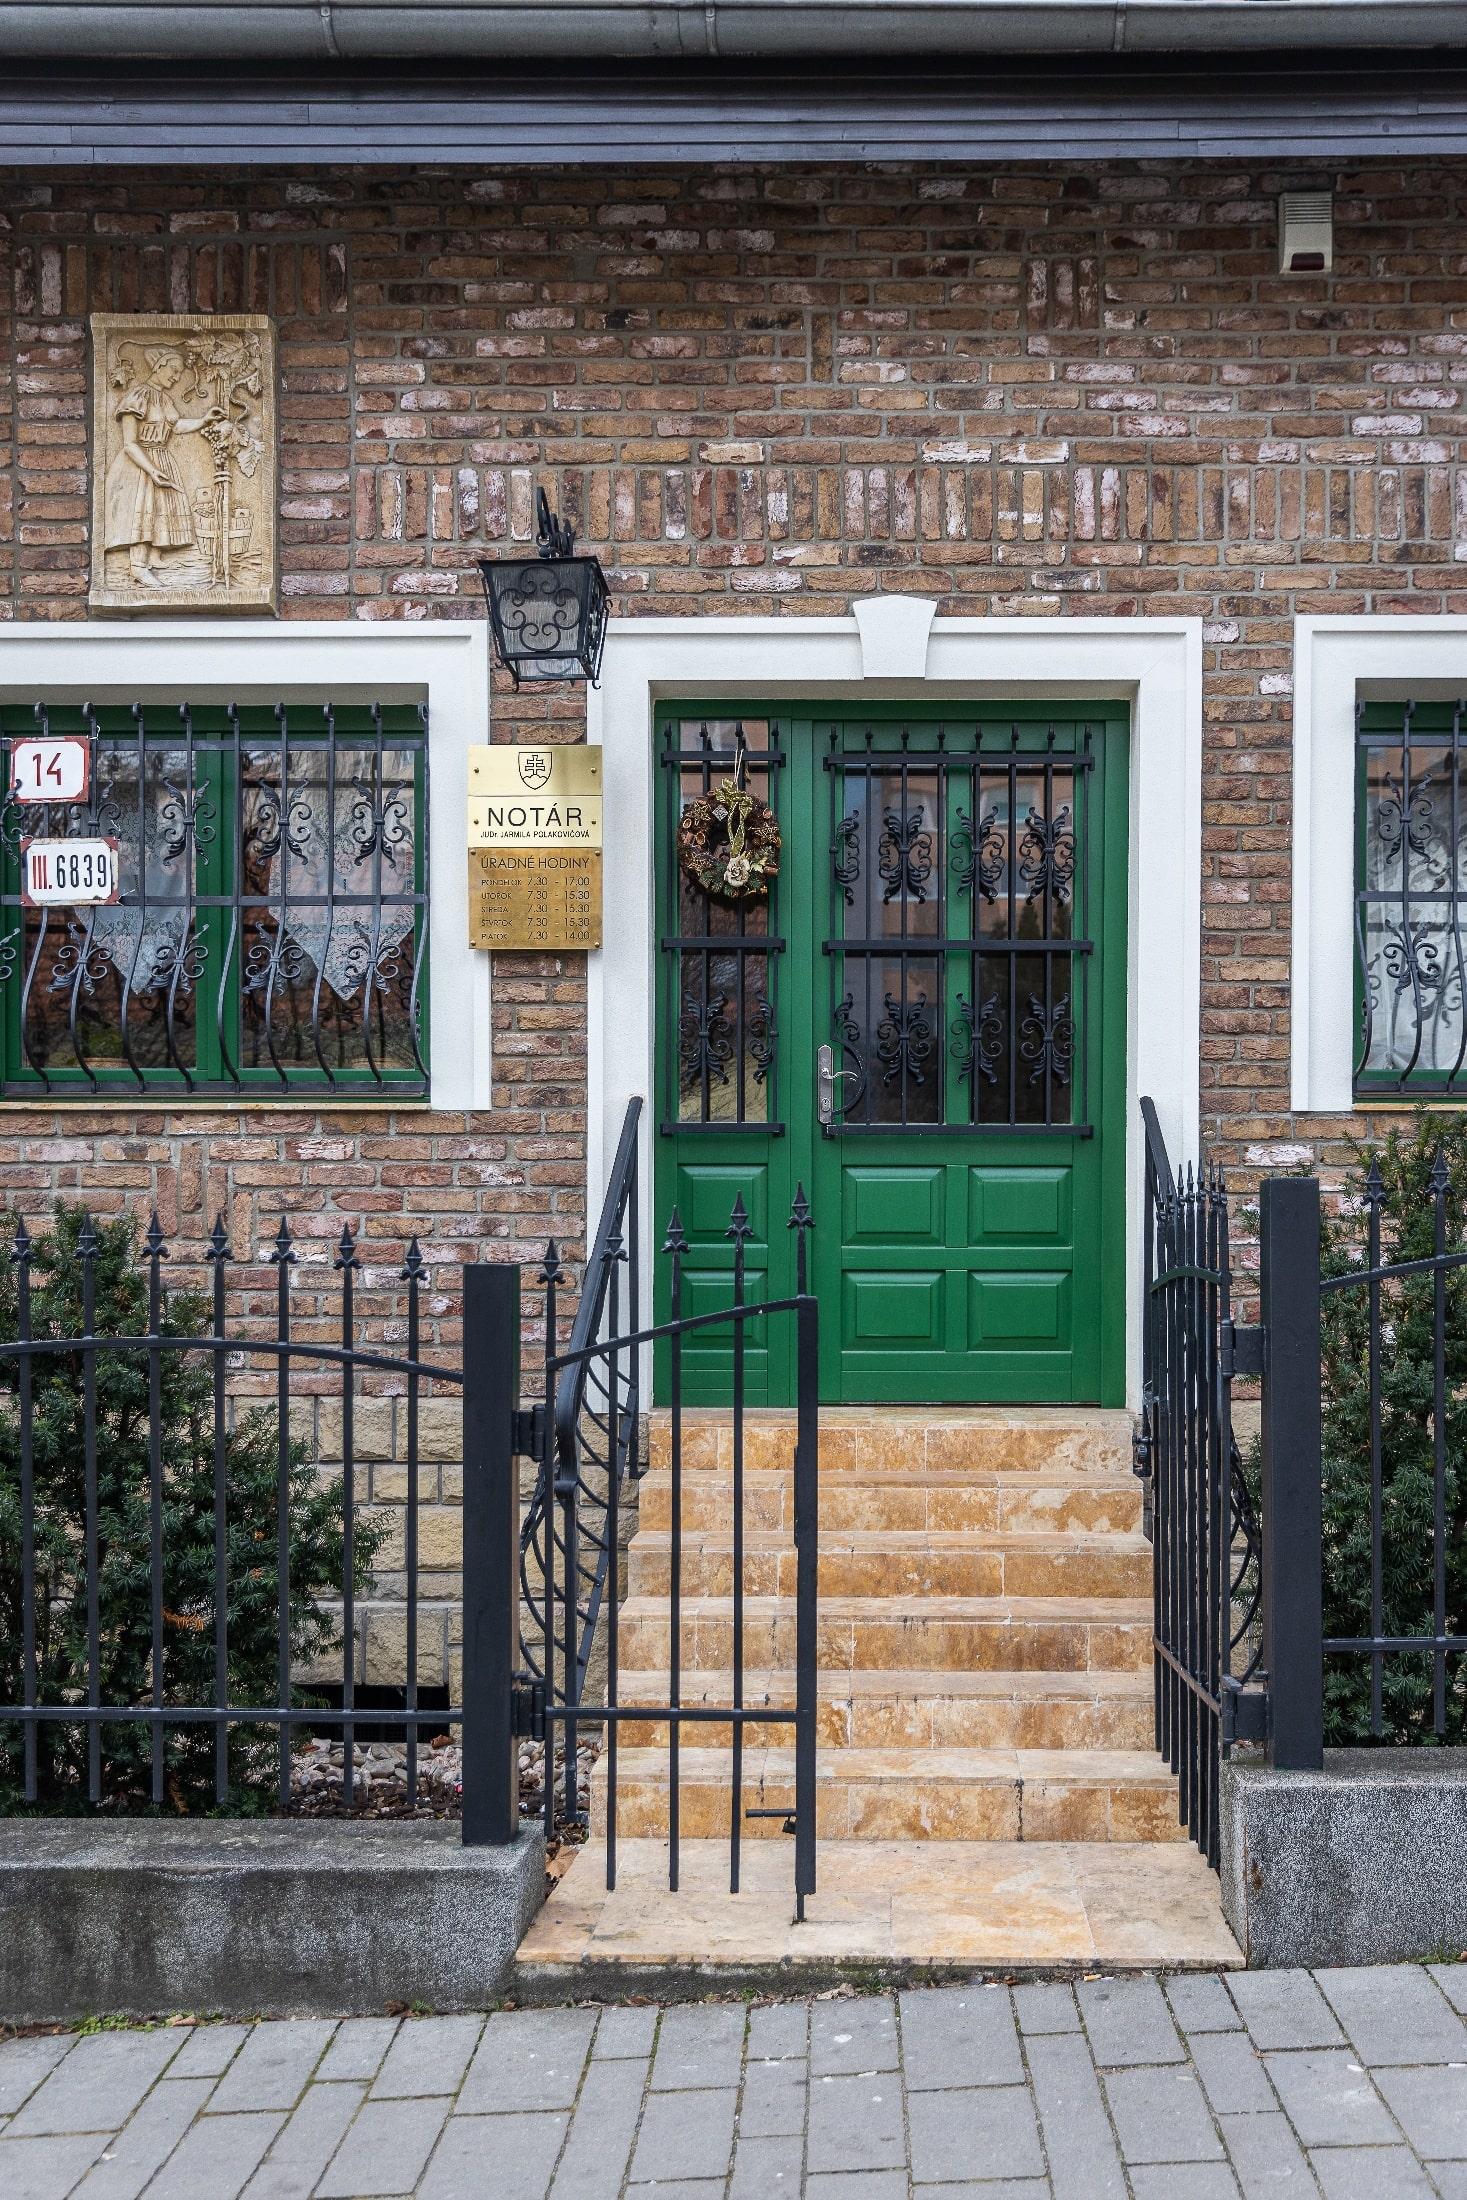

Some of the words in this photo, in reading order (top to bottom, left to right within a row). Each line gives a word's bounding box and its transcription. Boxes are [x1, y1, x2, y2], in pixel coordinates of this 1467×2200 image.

[33, 753, 61, 786] 14
[488, 803, 582, 826] NOTÁR
[481, 855, 534, 868] ÚRADNÉ
[538, 858, 589, 868] HODINY
[57, 854, 106, 888] 6839
[528, 877, 547, 885] 7.30
[565, 877, 589, 885] 17.00
[528, 891, 547, 899] 7.30
[565, 891, 589, 899] 15.30
[528, 905, 547, 913] 7.30
[565, 905, 589, 913] 15.30
[528, 918, 547, 926] 7.30
[565, 918, 589, 926] 15.30
[528, 932, 547, 940] 7.30
[565, 932, 589, 940] 14.00
